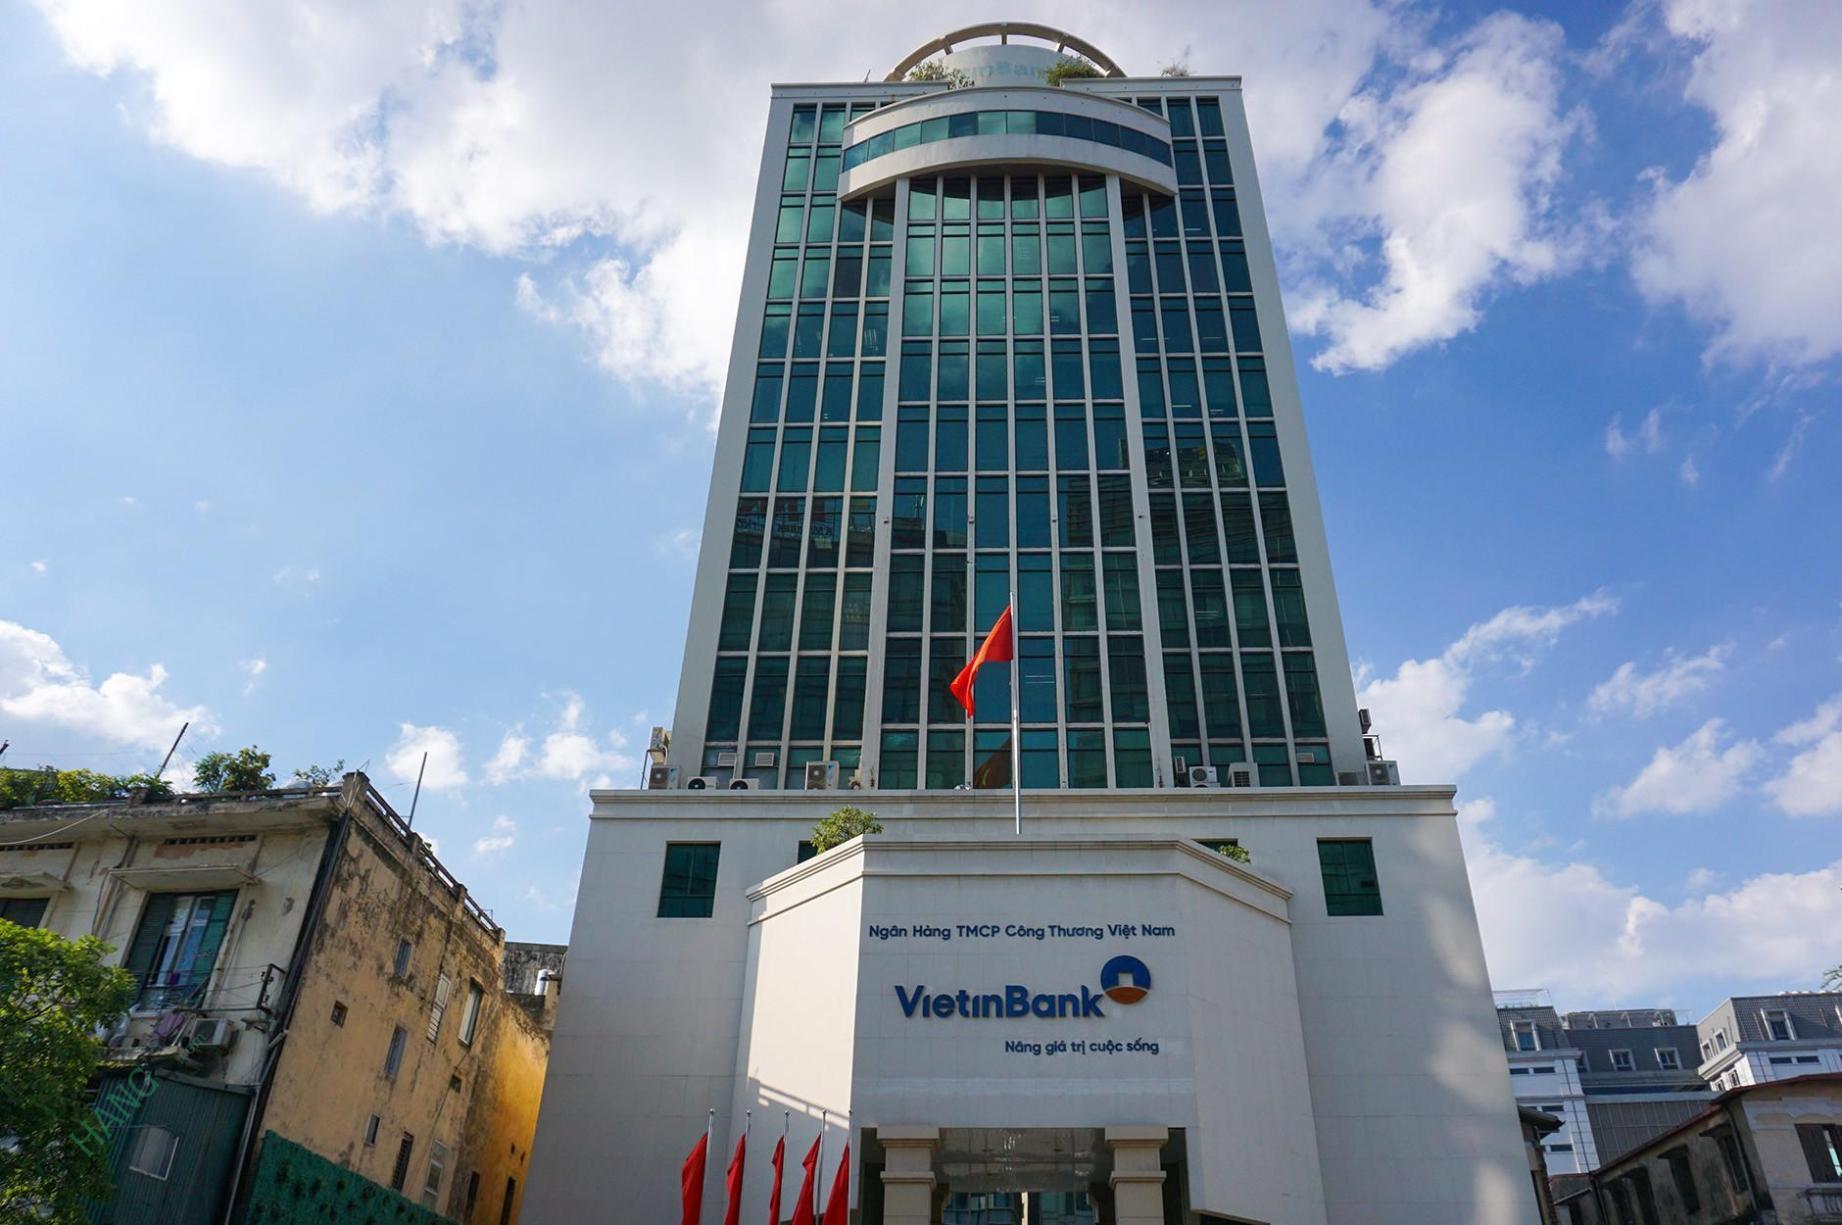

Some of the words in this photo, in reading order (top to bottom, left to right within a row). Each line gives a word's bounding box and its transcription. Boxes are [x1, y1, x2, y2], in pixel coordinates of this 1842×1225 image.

[869, 925, 907, 940] Ngân
[913, 925, 951, 940] Hàng
[956, 925, 1000, 937] TMCP
[1005, 925, 1045, 940] Công
[1048, 925, 1104, 940] Thương
[1107, 924, 1137, 939] Việt
[1142, 924, 1175, 937] Nam
[894, 985, 1105, 1018] VietinBank
[1005, 1040, 1041, 1056] Nâng
[1045, 1040, 1067, 1055] giá
[1071, 1041, 1085, 1055] trị
[1089, 1040, 1123, 1054] cuộc
[1126, 1037, 1159, 1055] sống
